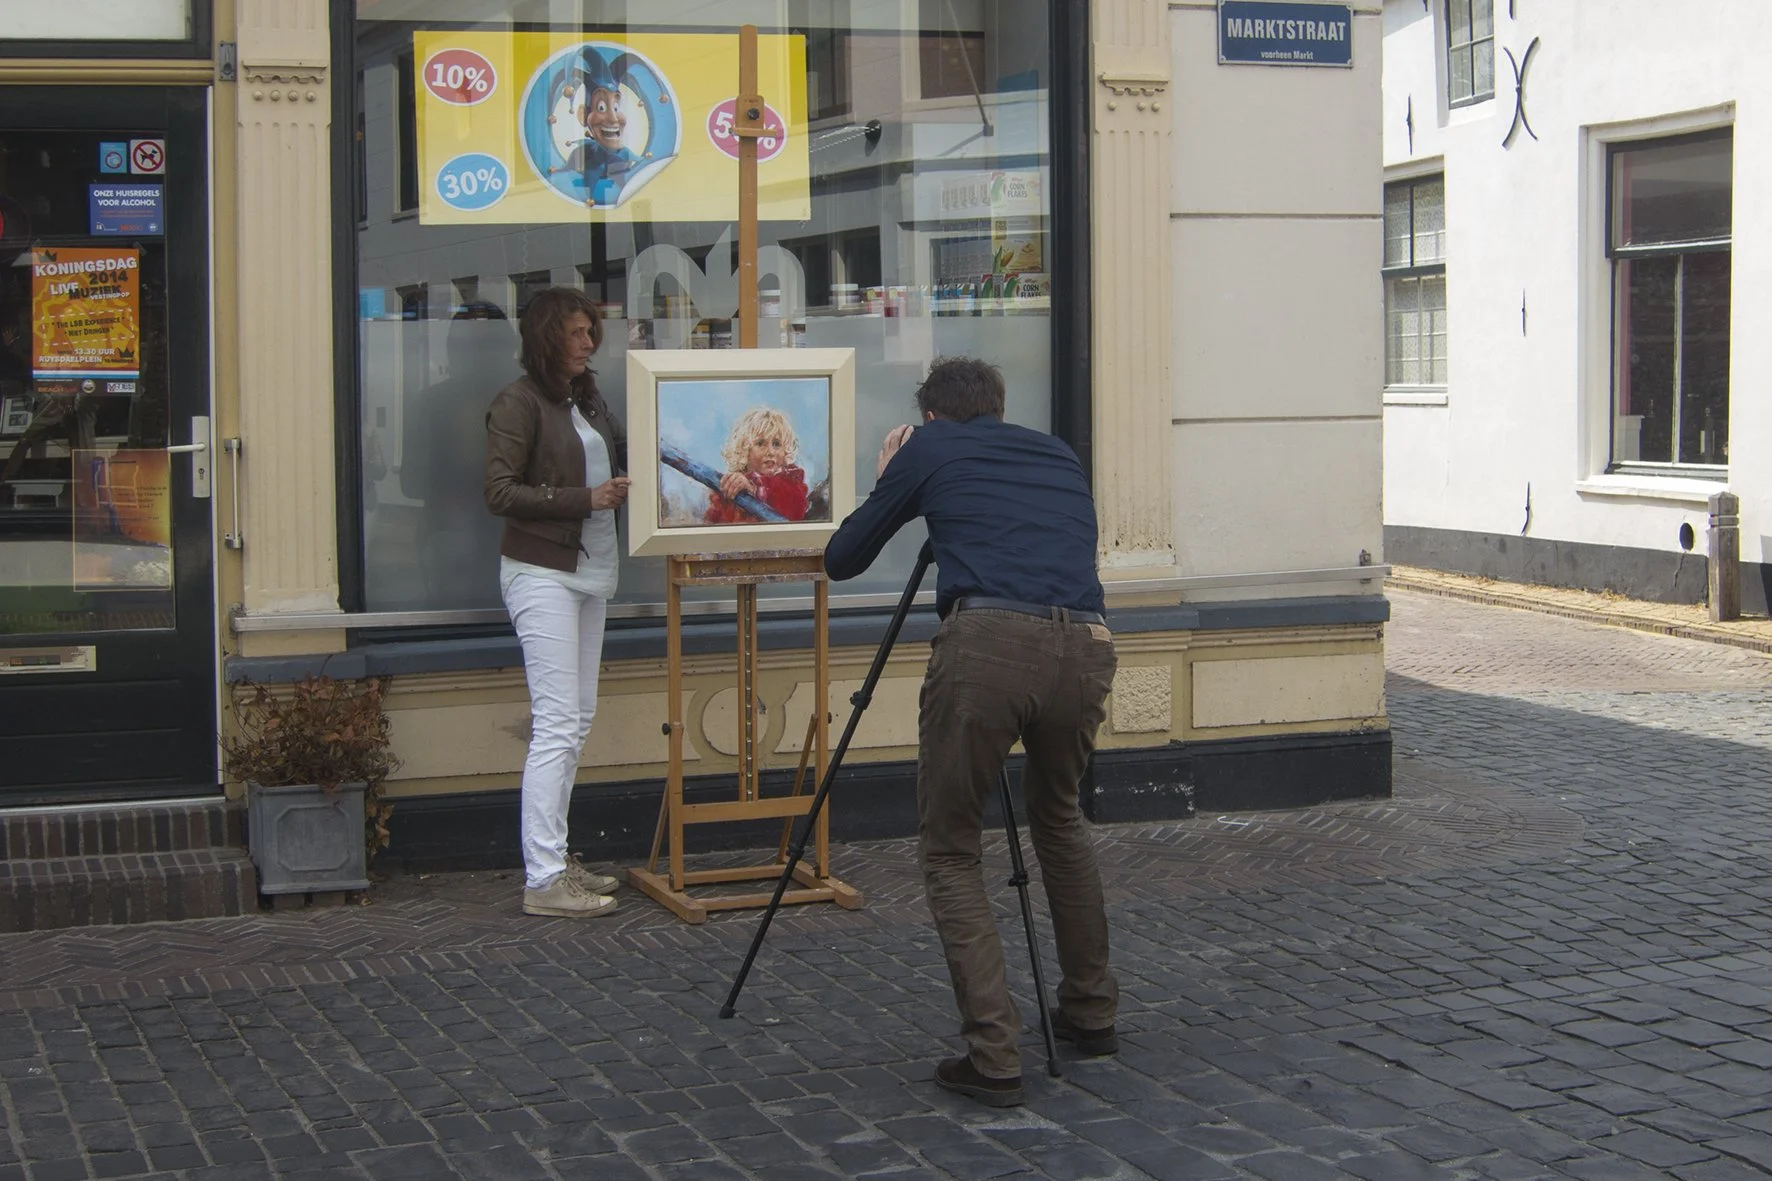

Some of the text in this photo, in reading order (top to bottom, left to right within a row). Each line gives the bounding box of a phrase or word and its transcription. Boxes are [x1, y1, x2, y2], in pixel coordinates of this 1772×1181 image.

[1227, 17, 1346, 41] MARKTSTRAAT
[1261, 50, 1314, 60] voorheen Markt
[431, 63, 488, 92] 10%
[713, 111, 776, 150] 5%
[442, 167, 503, 200] 30%
[1010, 182, 1025, 190] CORN
[1007, 190, 1028, 198] FLAKES
[35, 256, 137, 277] KONINGSDAG
[89, 270, 128, 285] 2014
[50, 282, 79, 295] LIVE
[69, 284, 122, 299] MUZIEK
[1023, 283, 1039, 291] CORN
